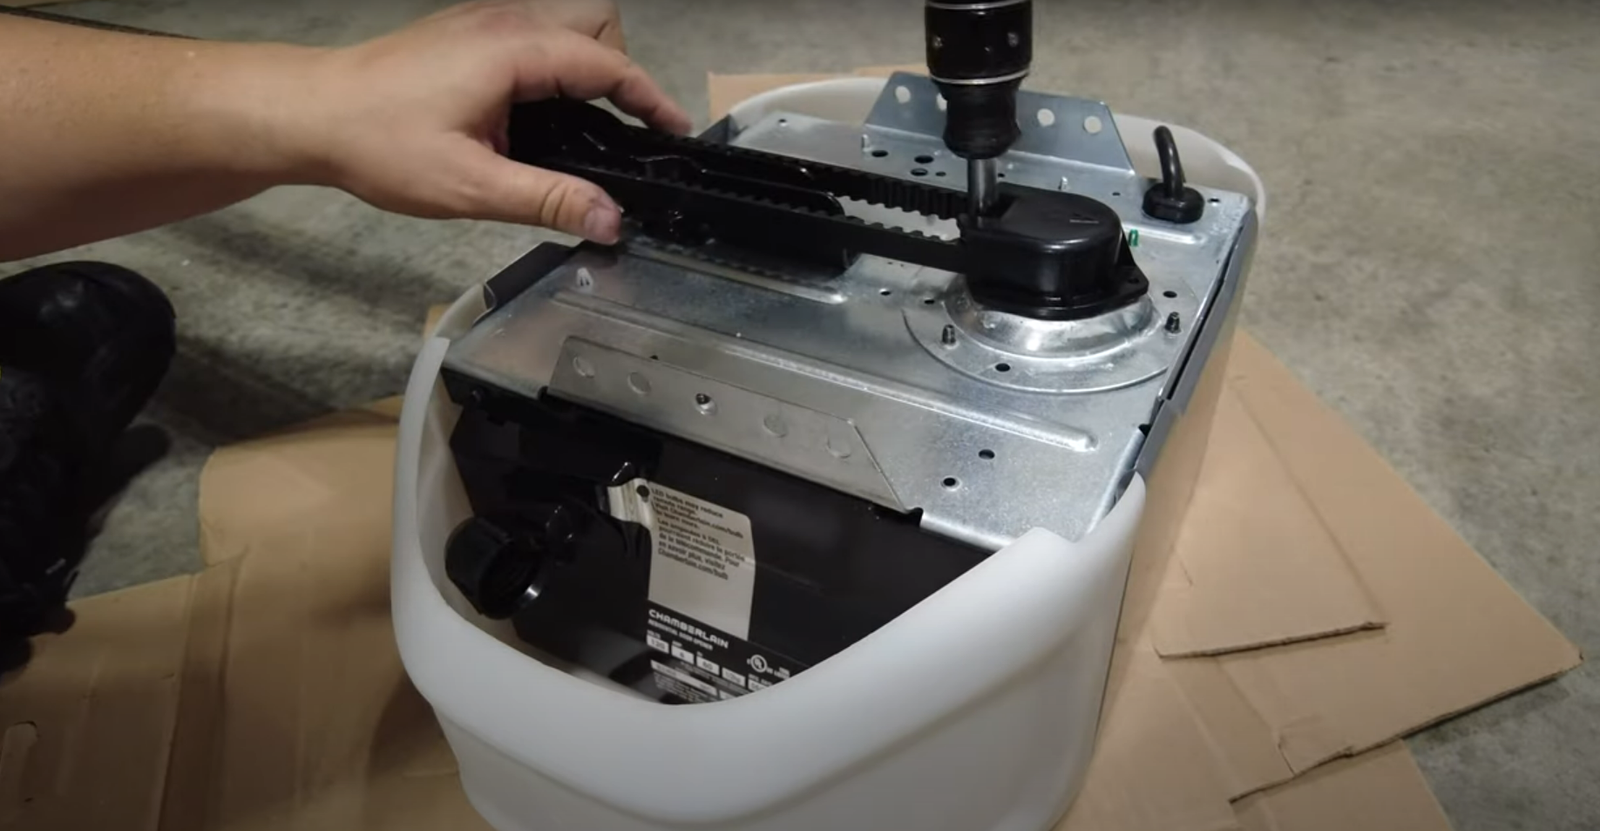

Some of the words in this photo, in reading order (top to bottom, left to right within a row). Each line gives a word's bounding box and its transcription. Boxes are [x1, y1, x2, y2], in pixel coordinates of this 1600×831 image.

[651, 487, 664, 497] LED
[666, 493, 683, 504] bulbs
[685, 500, 699, 511] may
[701, 505, 723, 518] reduce
[648, 609, 729, 649] CHAMBERLAIN
